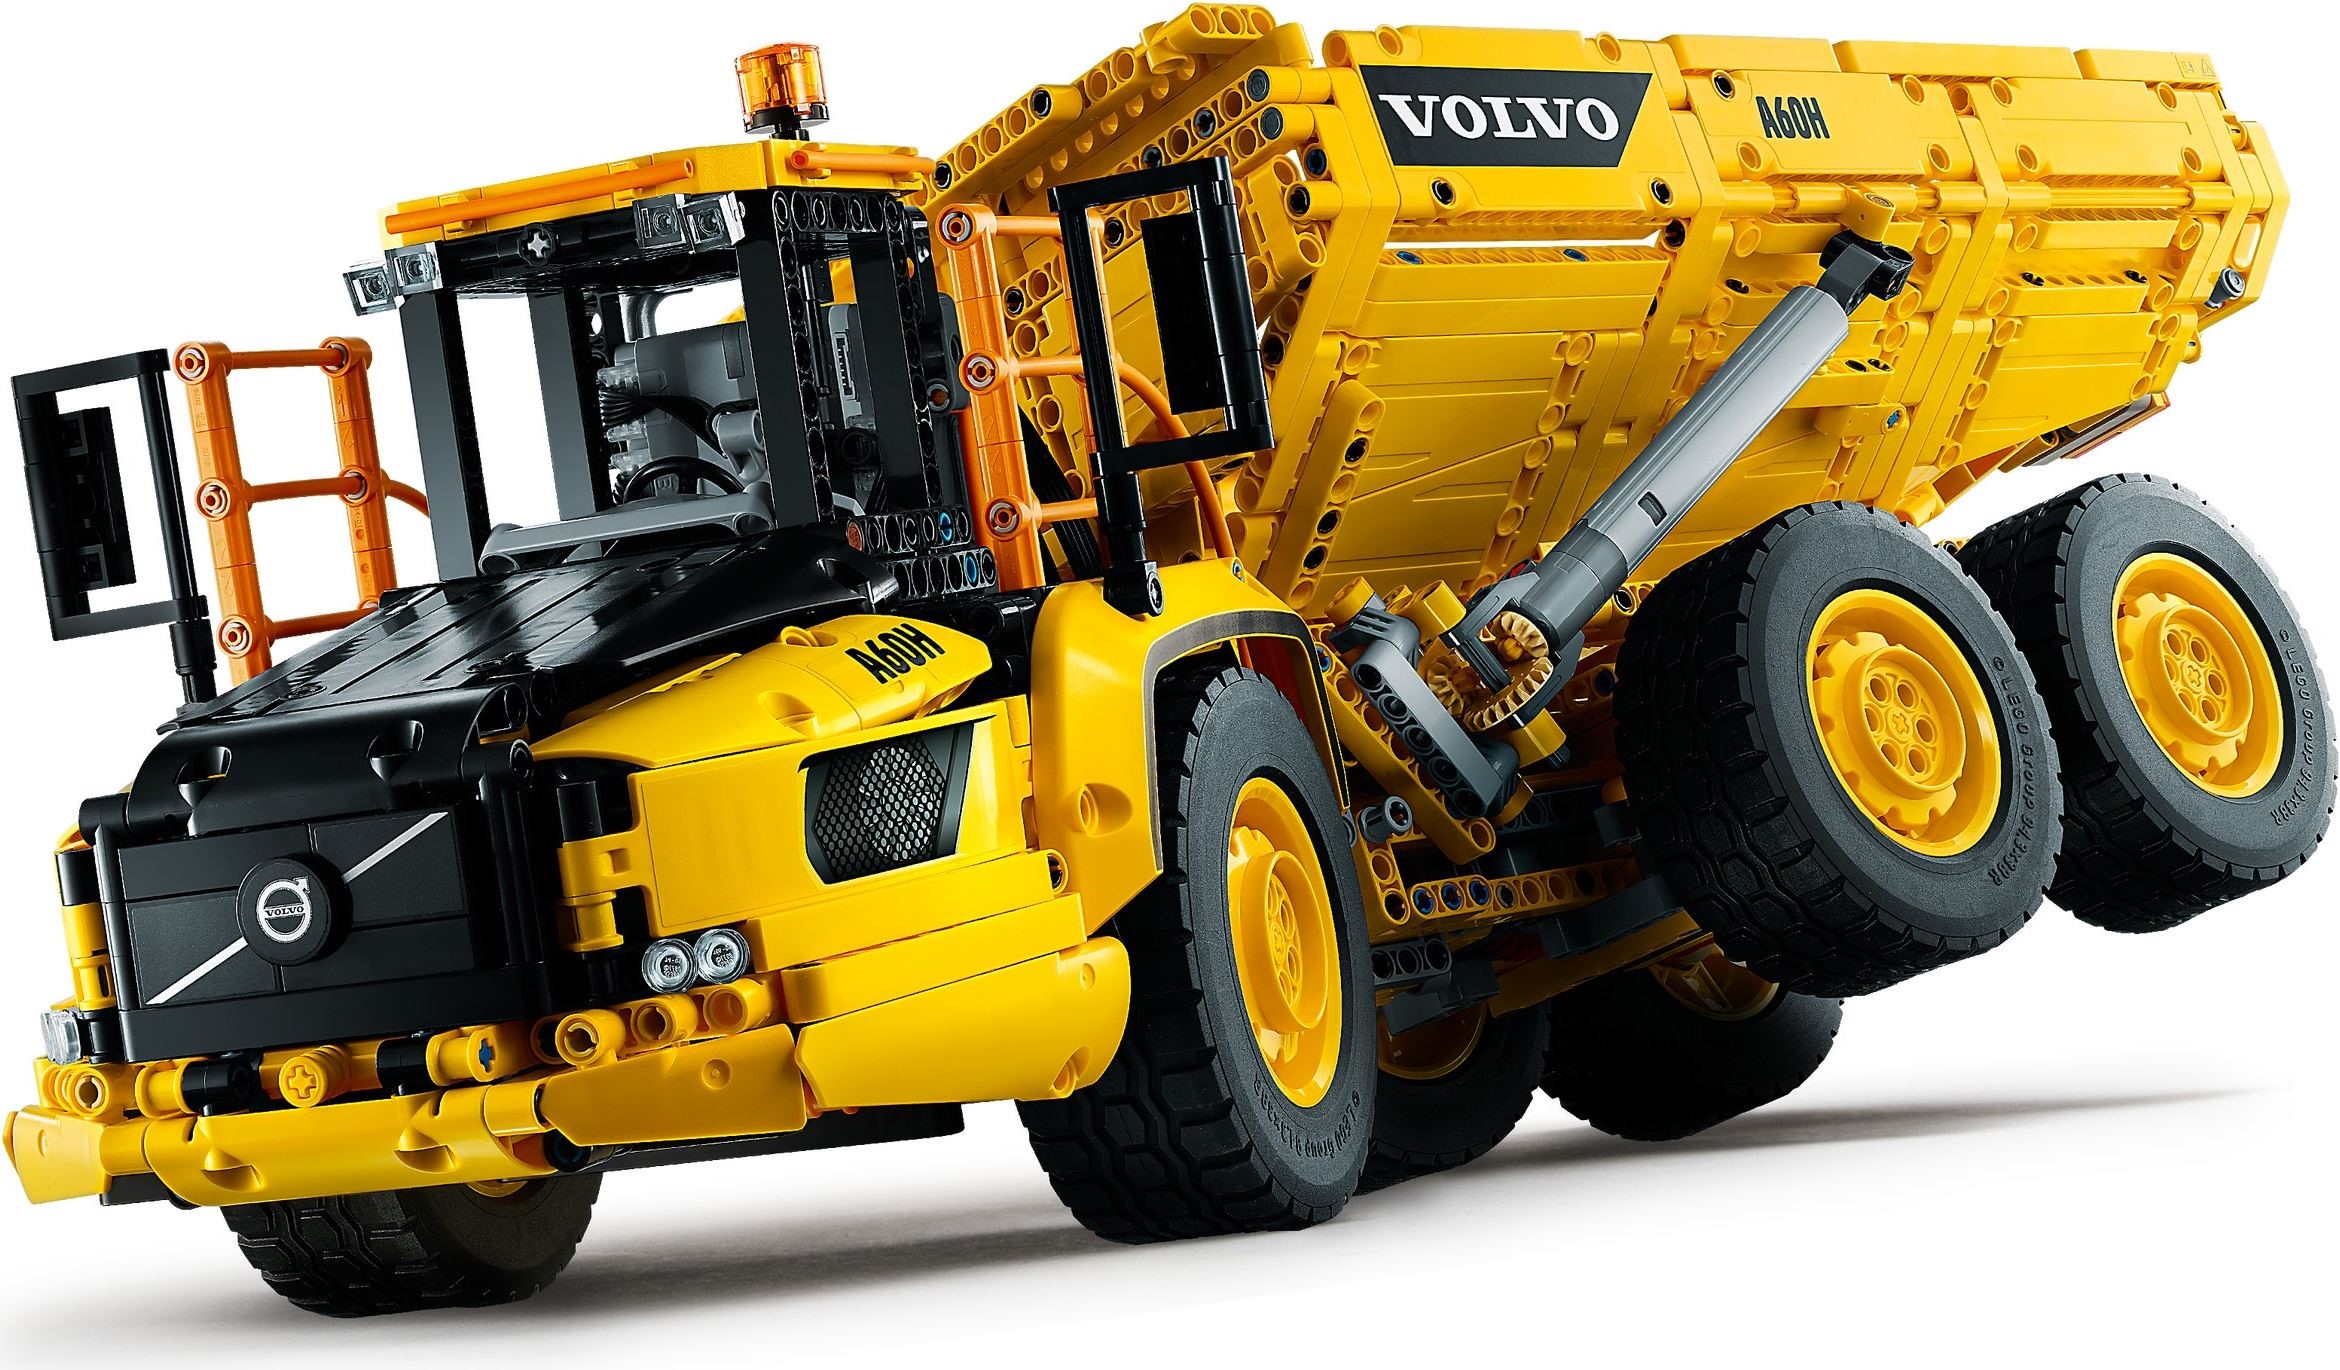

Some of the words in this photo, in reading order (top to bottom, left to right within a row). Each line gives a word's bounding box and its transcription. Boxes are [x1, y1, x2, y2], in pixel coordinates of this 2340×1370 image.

[1378, 94, 1621, 141] VOLVO
[1755, 95, 1831, 140] A60H
[844, 622, 946, 684] A60H
[2285, 648, 2311, 701] LEGO
[2302, 707, 2314, 766] Group
[2001, 676, 2030, 735] LEGO
[2020, 746, 2035, 810] Group
[265, 905, 305, 917] VOLVO
[1334, 1104, 1357, 1151] LEGO
